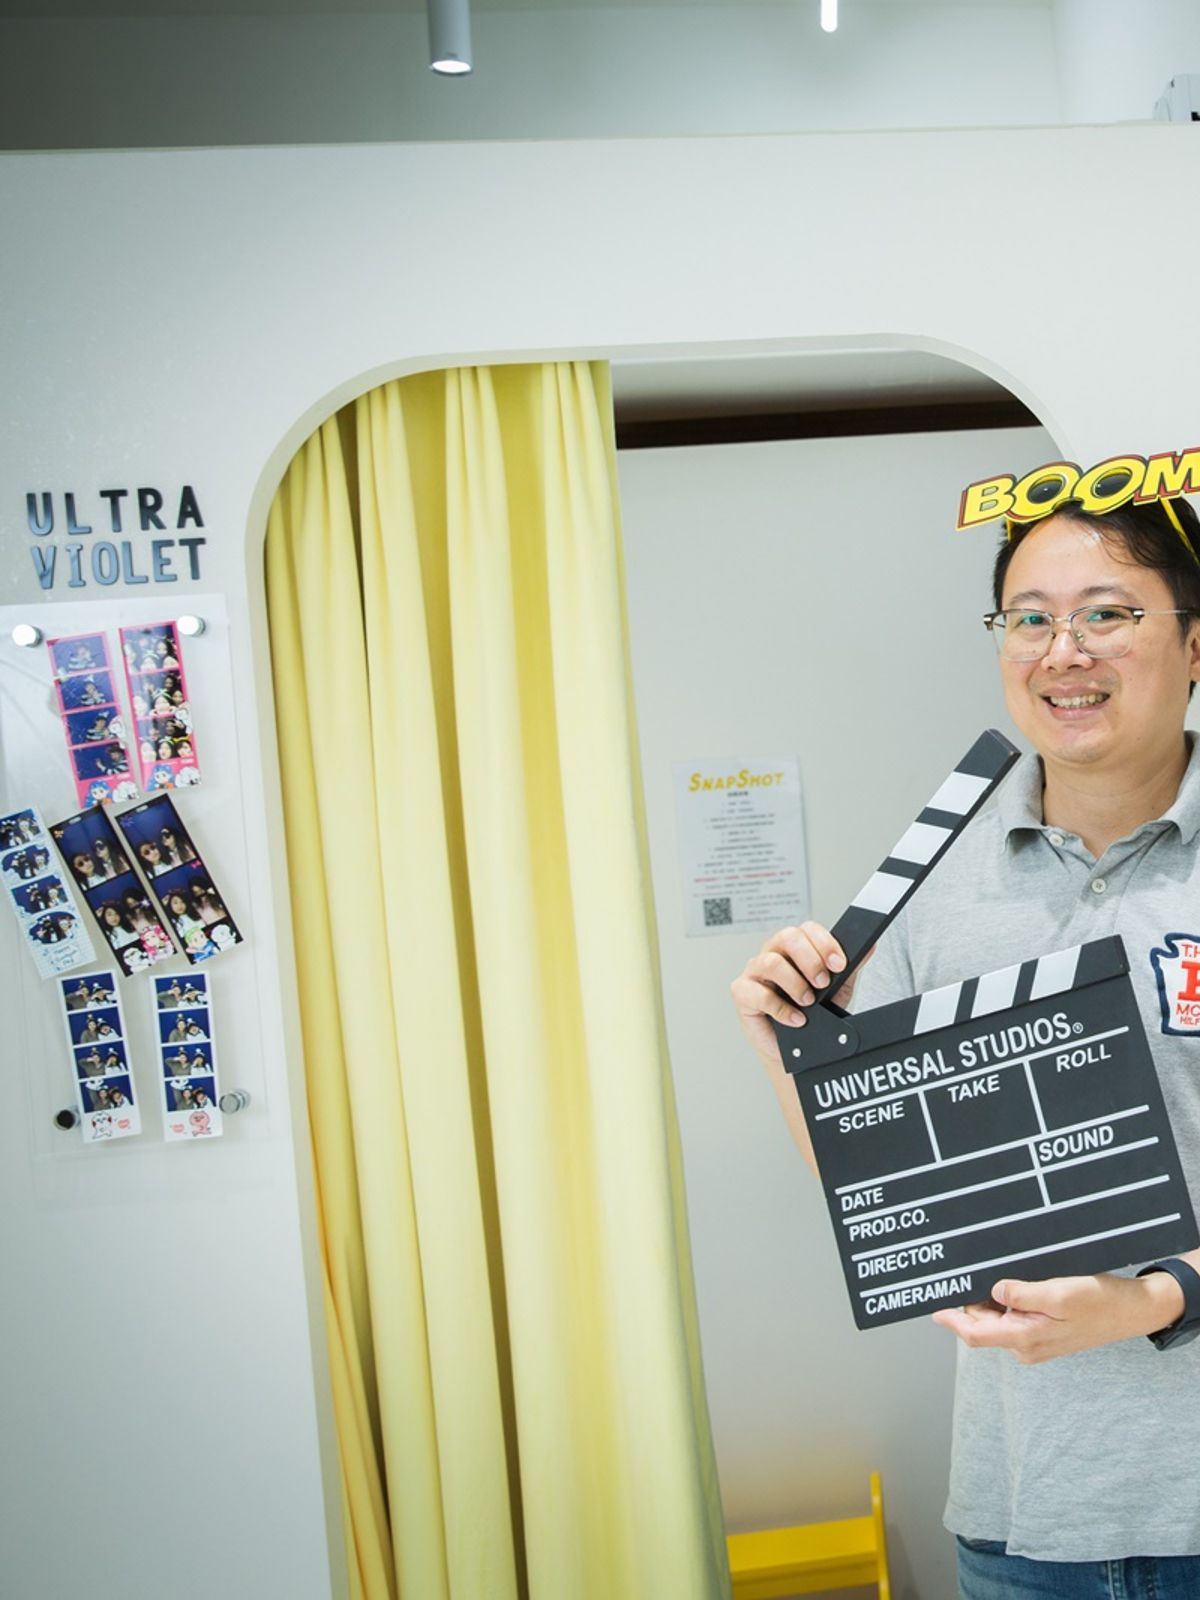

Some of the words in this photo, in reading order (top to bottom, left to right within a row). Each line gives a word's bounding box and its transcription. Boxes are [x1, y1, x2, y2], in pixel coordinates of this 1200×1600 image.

[26, 485, 205, 536] ULTRA
[31, 538, 207, 589] VIOLET
[814, 1049, 955, 1108] UNIVERSAL
[838, 1101, 906, 1134] SCENE
[947, 1074, 1001, 1103] TAKE
[1056, 1043, 1112, 1073] ROLL
[1038, 1124, 1114, 1162] SOUND
[840, 1187, 884, 1212] DATE
[849, 1208, 930, 1242] PROD.CO.
[857, 1243, 945, 1279] DIRECTOR
[865, 1275, 972, 1315] CAMERAMAN
